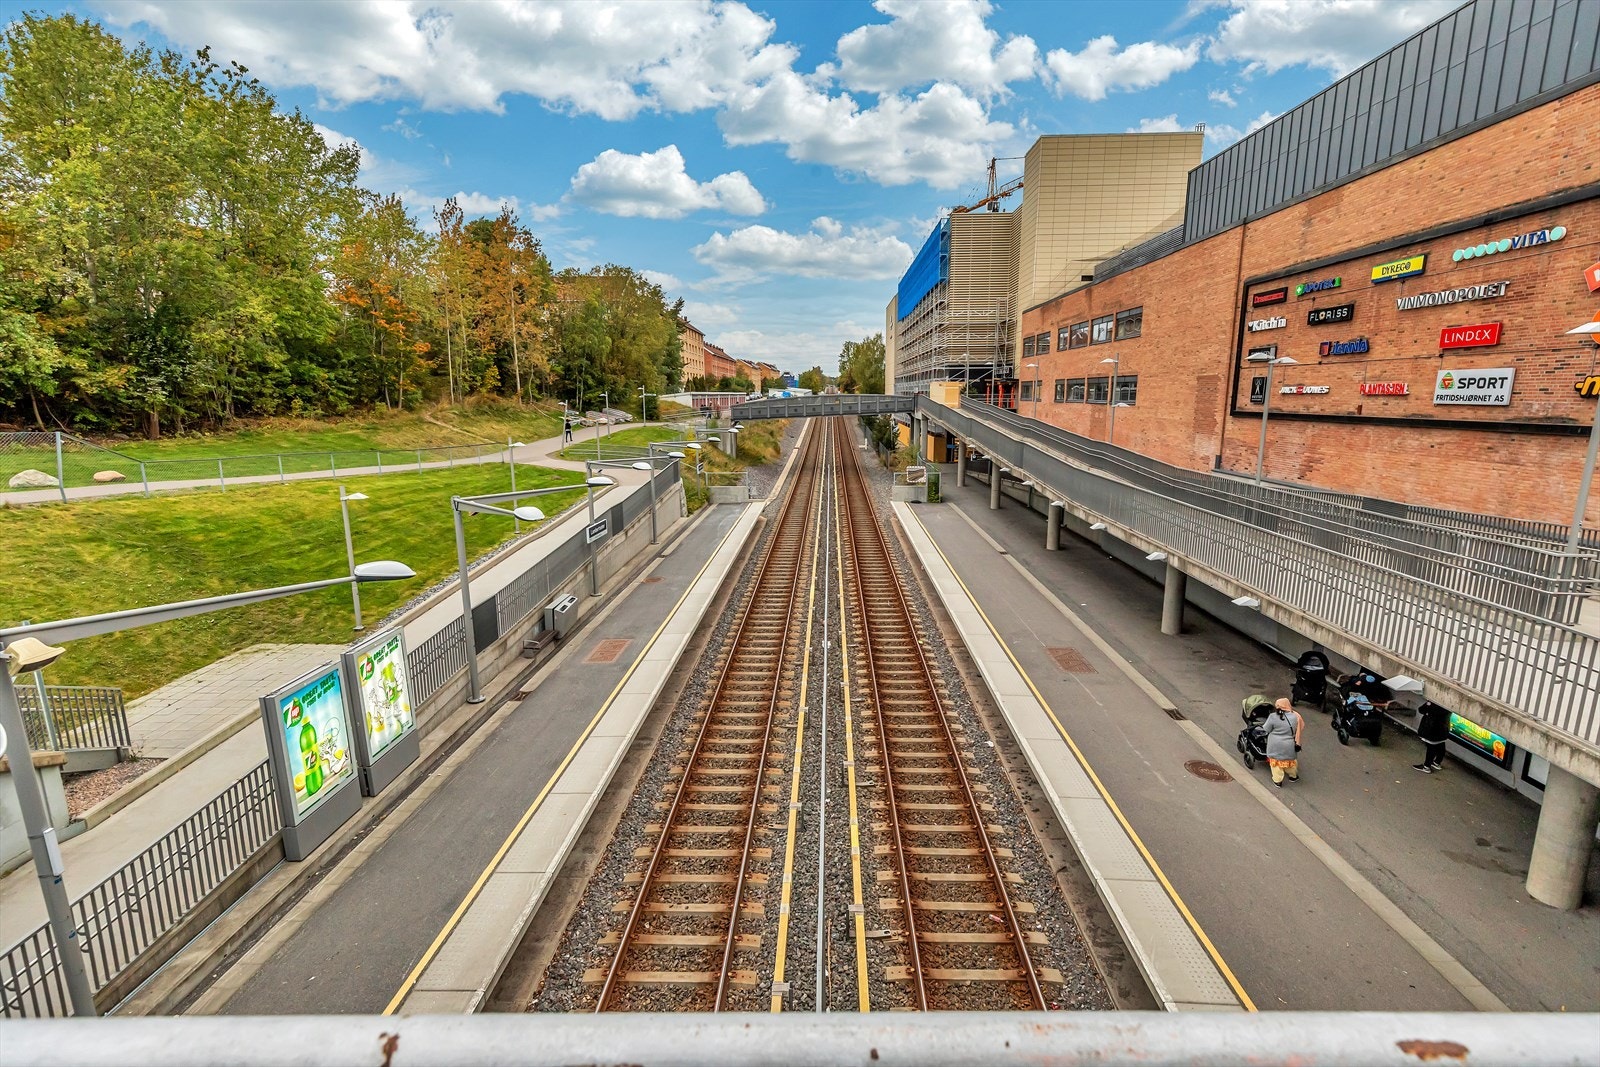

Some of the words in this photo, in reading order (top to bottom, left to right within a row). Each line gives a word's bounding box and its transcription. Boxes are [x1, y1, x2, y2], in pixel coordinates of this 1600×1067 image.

[1511, 230, 1550, 249] VITA
[1303, 280, 1334, 293] APOTEK
[1396, 281, 1510, 310] VINMONOPOLET
[1310, 307, 1348, 322] FLORISS
[1444, 329, 1492, 344] LINDEX
[1359, 383, 1408, 395] PLANTASJEN
[1457, 377, 1508, 390] SPORT
[1435, 394, 1492, 402] FRITIDSHJØRNET
[1494, 394, 1505, 403] AS
